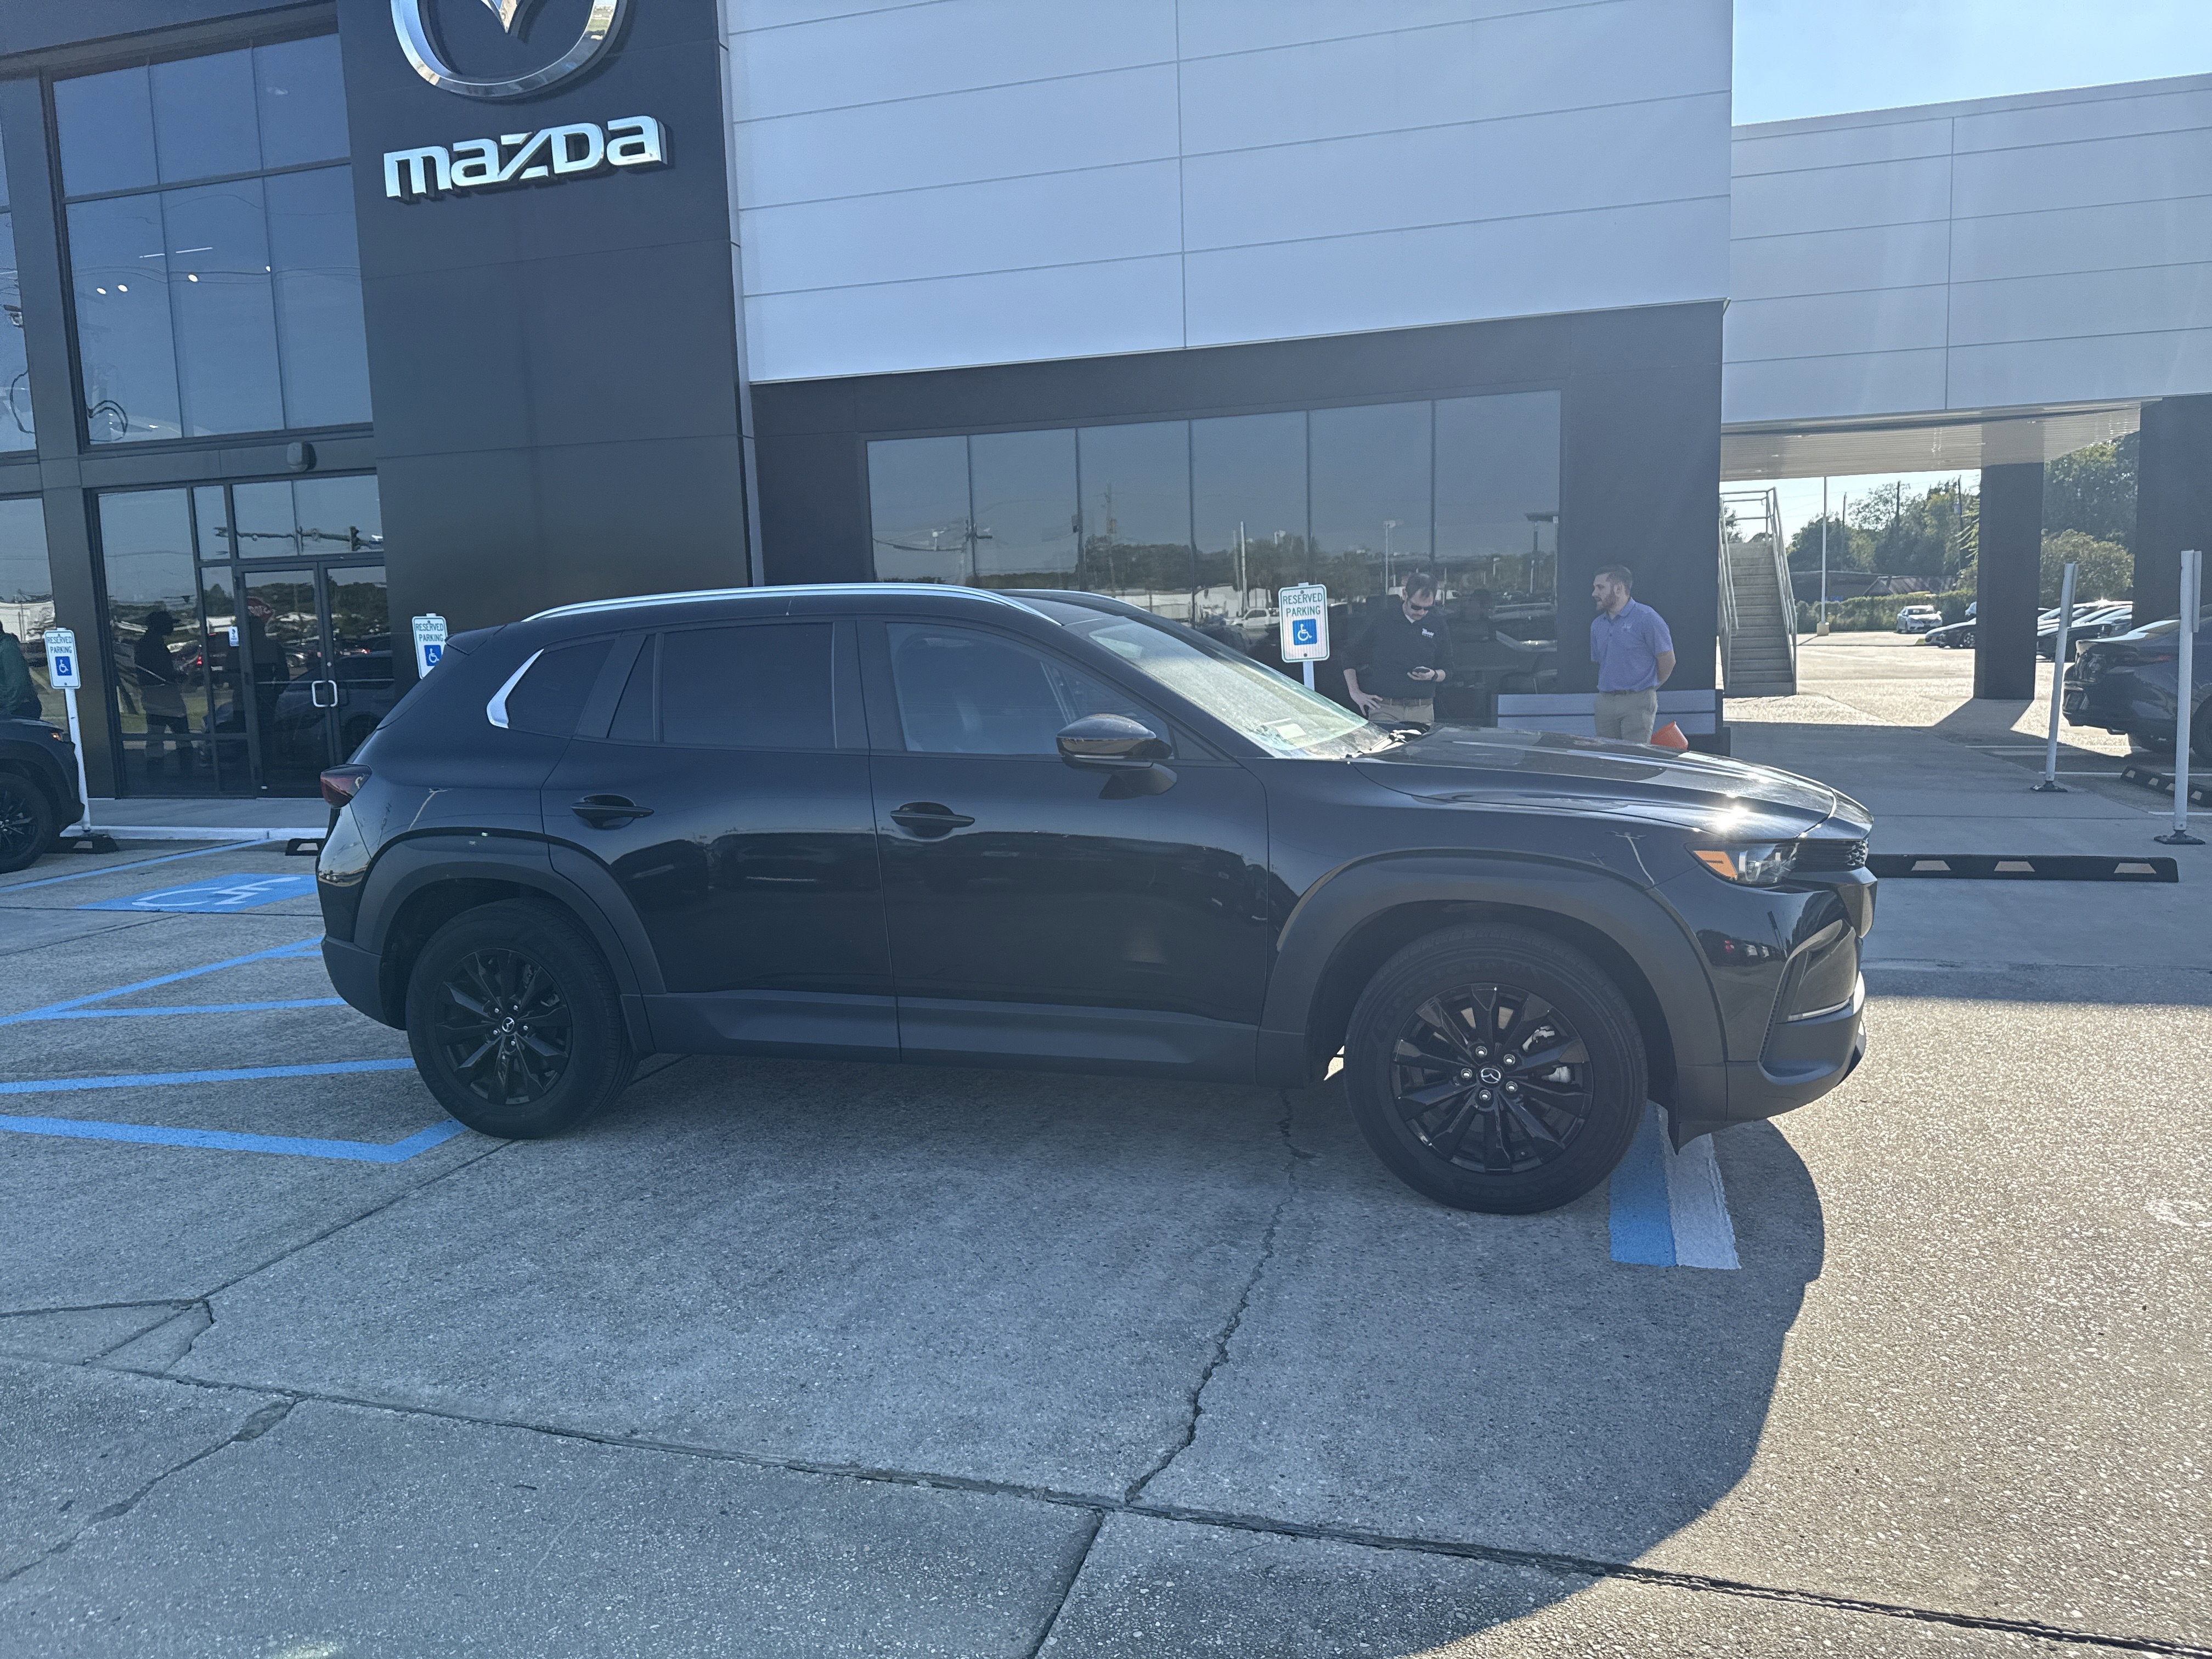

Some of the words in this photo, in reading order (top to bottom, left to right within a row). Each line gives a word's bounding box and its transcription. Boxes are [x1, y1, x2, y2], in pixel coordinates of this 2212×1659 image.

[383, 115, 666, 200] mazda
[1283, 593, 1323, 605] RESERVED
[1286, 606, 1321, 617] PARKING
[415, 623, 444, 631] RESERVED
[47, 636, 72, 644] RESERVED
[50, 646, 72, 654] PARKING
